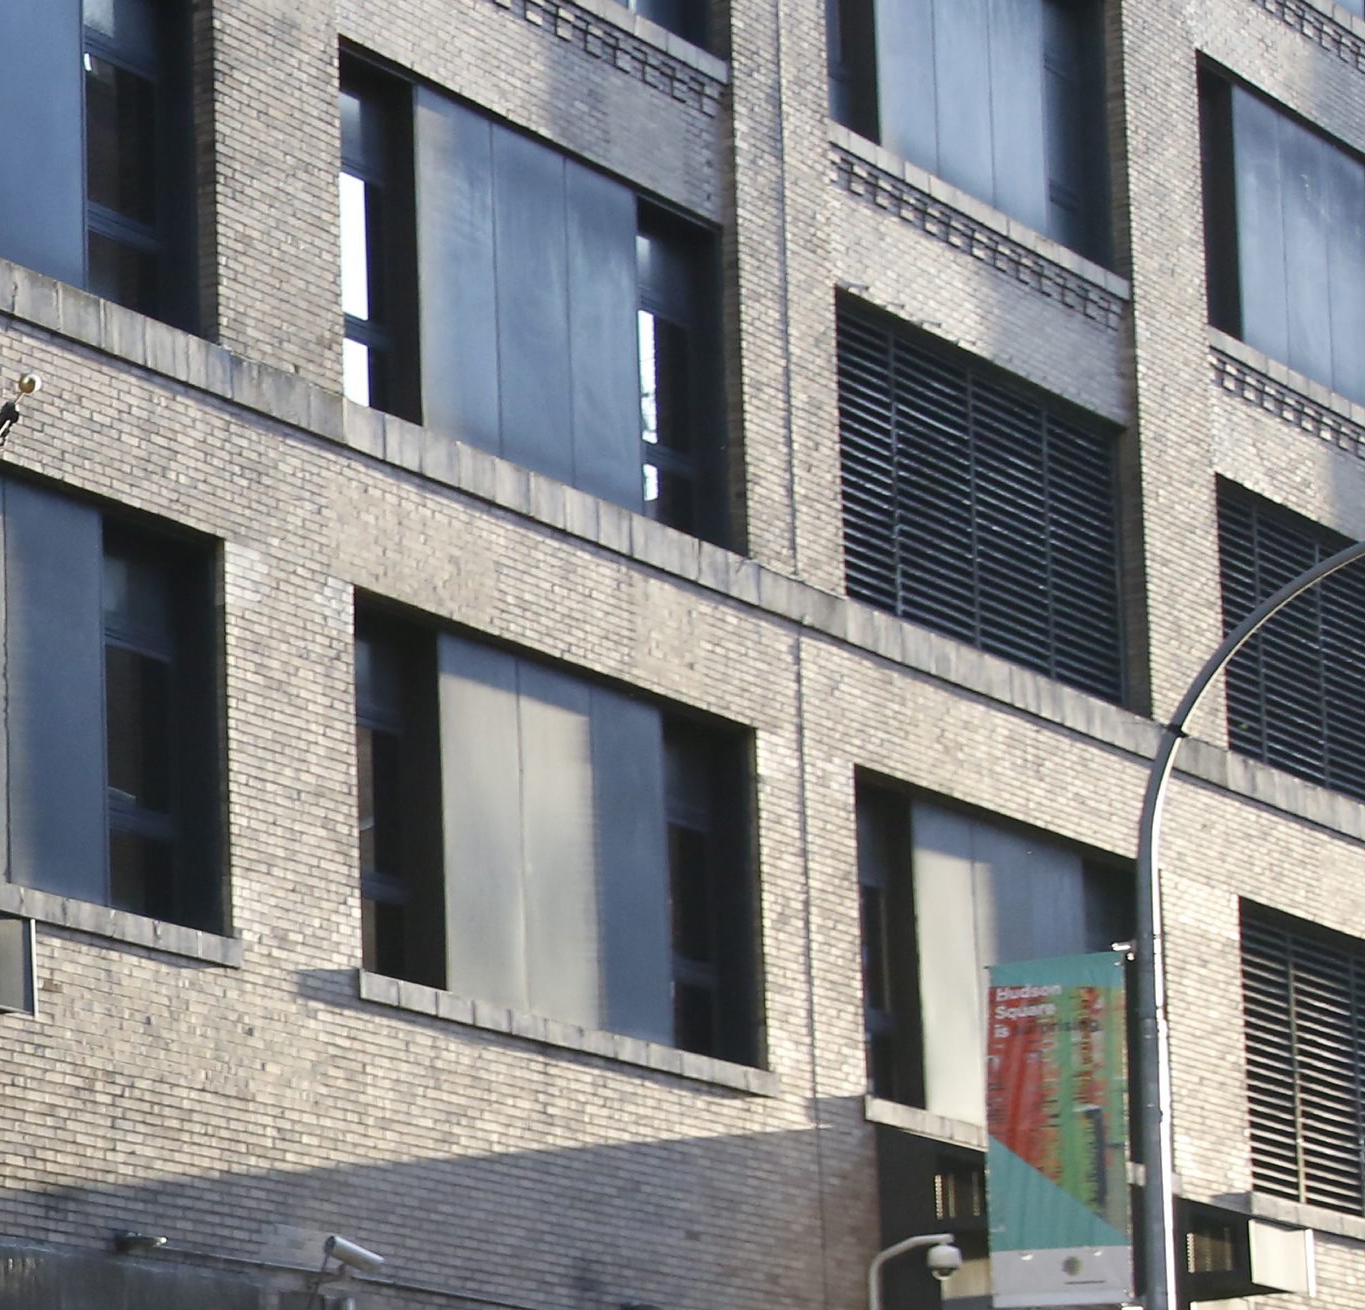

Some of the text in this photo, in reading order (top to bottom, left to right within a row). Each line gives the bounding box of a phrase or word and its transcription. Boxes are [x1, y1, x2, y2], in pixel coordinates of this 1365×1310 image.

[995, 985, 1062, 1001] Hudson
[995, 1003, 1056, 1019] Square
[994, 1024, 1010, 1038] is
